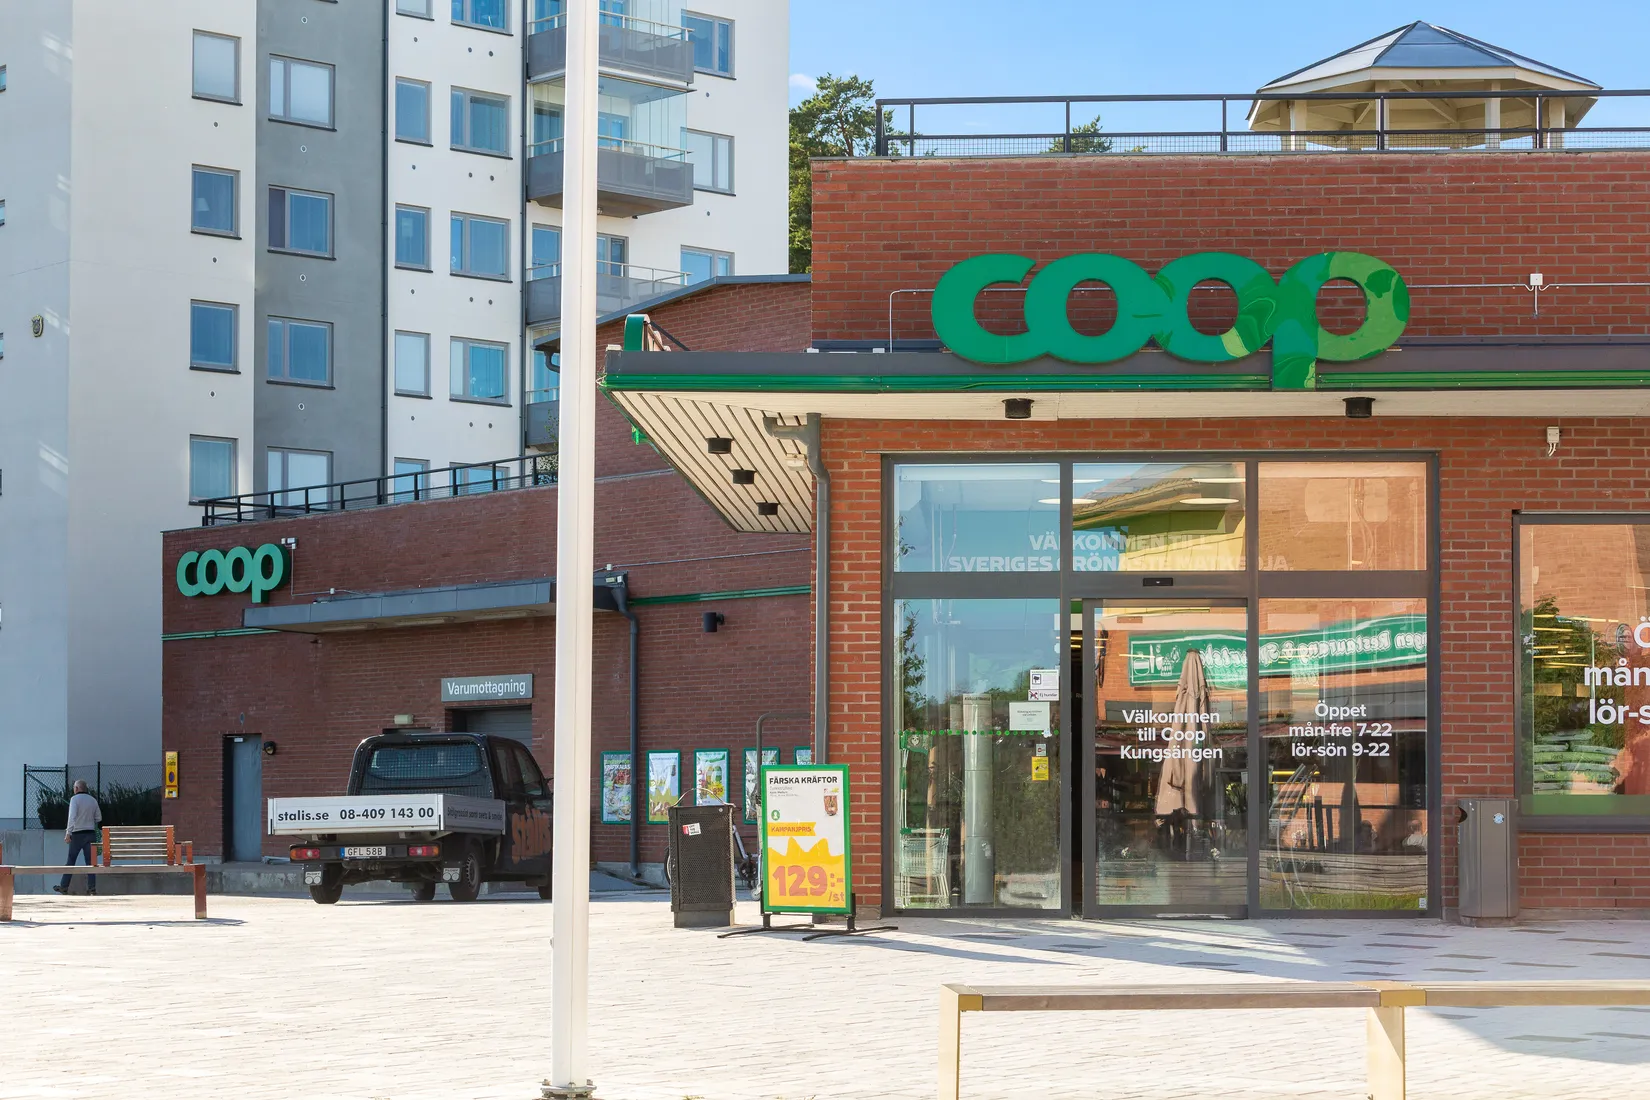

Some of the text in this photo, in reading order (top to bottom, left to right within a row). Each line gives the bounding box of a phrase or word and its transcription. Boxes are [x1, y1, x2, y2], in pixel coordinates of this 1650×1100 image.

[931, 251, 1410, 389] coop
[1029, 531, 1164, 550] VÄKOMMEN
[950, 556, 1052, 571] SVERIGES
[1057, 552, 1169, 571] RÖNASTE
[176, 543, 288, 603] coop
[447, 679, 526, 696] Varumottagning
[1122, 709, 1220, 723] Välkommen
[1315, 700, 1367, 720] Öppet
[1137, 727, 1206, 744] till Coop
[1289, 721, 1393, 737] mån-fre 7-22
[1120, 745, 1223, 762] Kungsängen
[1291, 743, 1390, 757] lör-sön 9-22
[769, 776, 838, 785] FÄRSKA KRÄFTOR
[278, 807, 434, 821] stalis.se 08-409 143 00
[347, 847, 383, 856] GFL 58B
